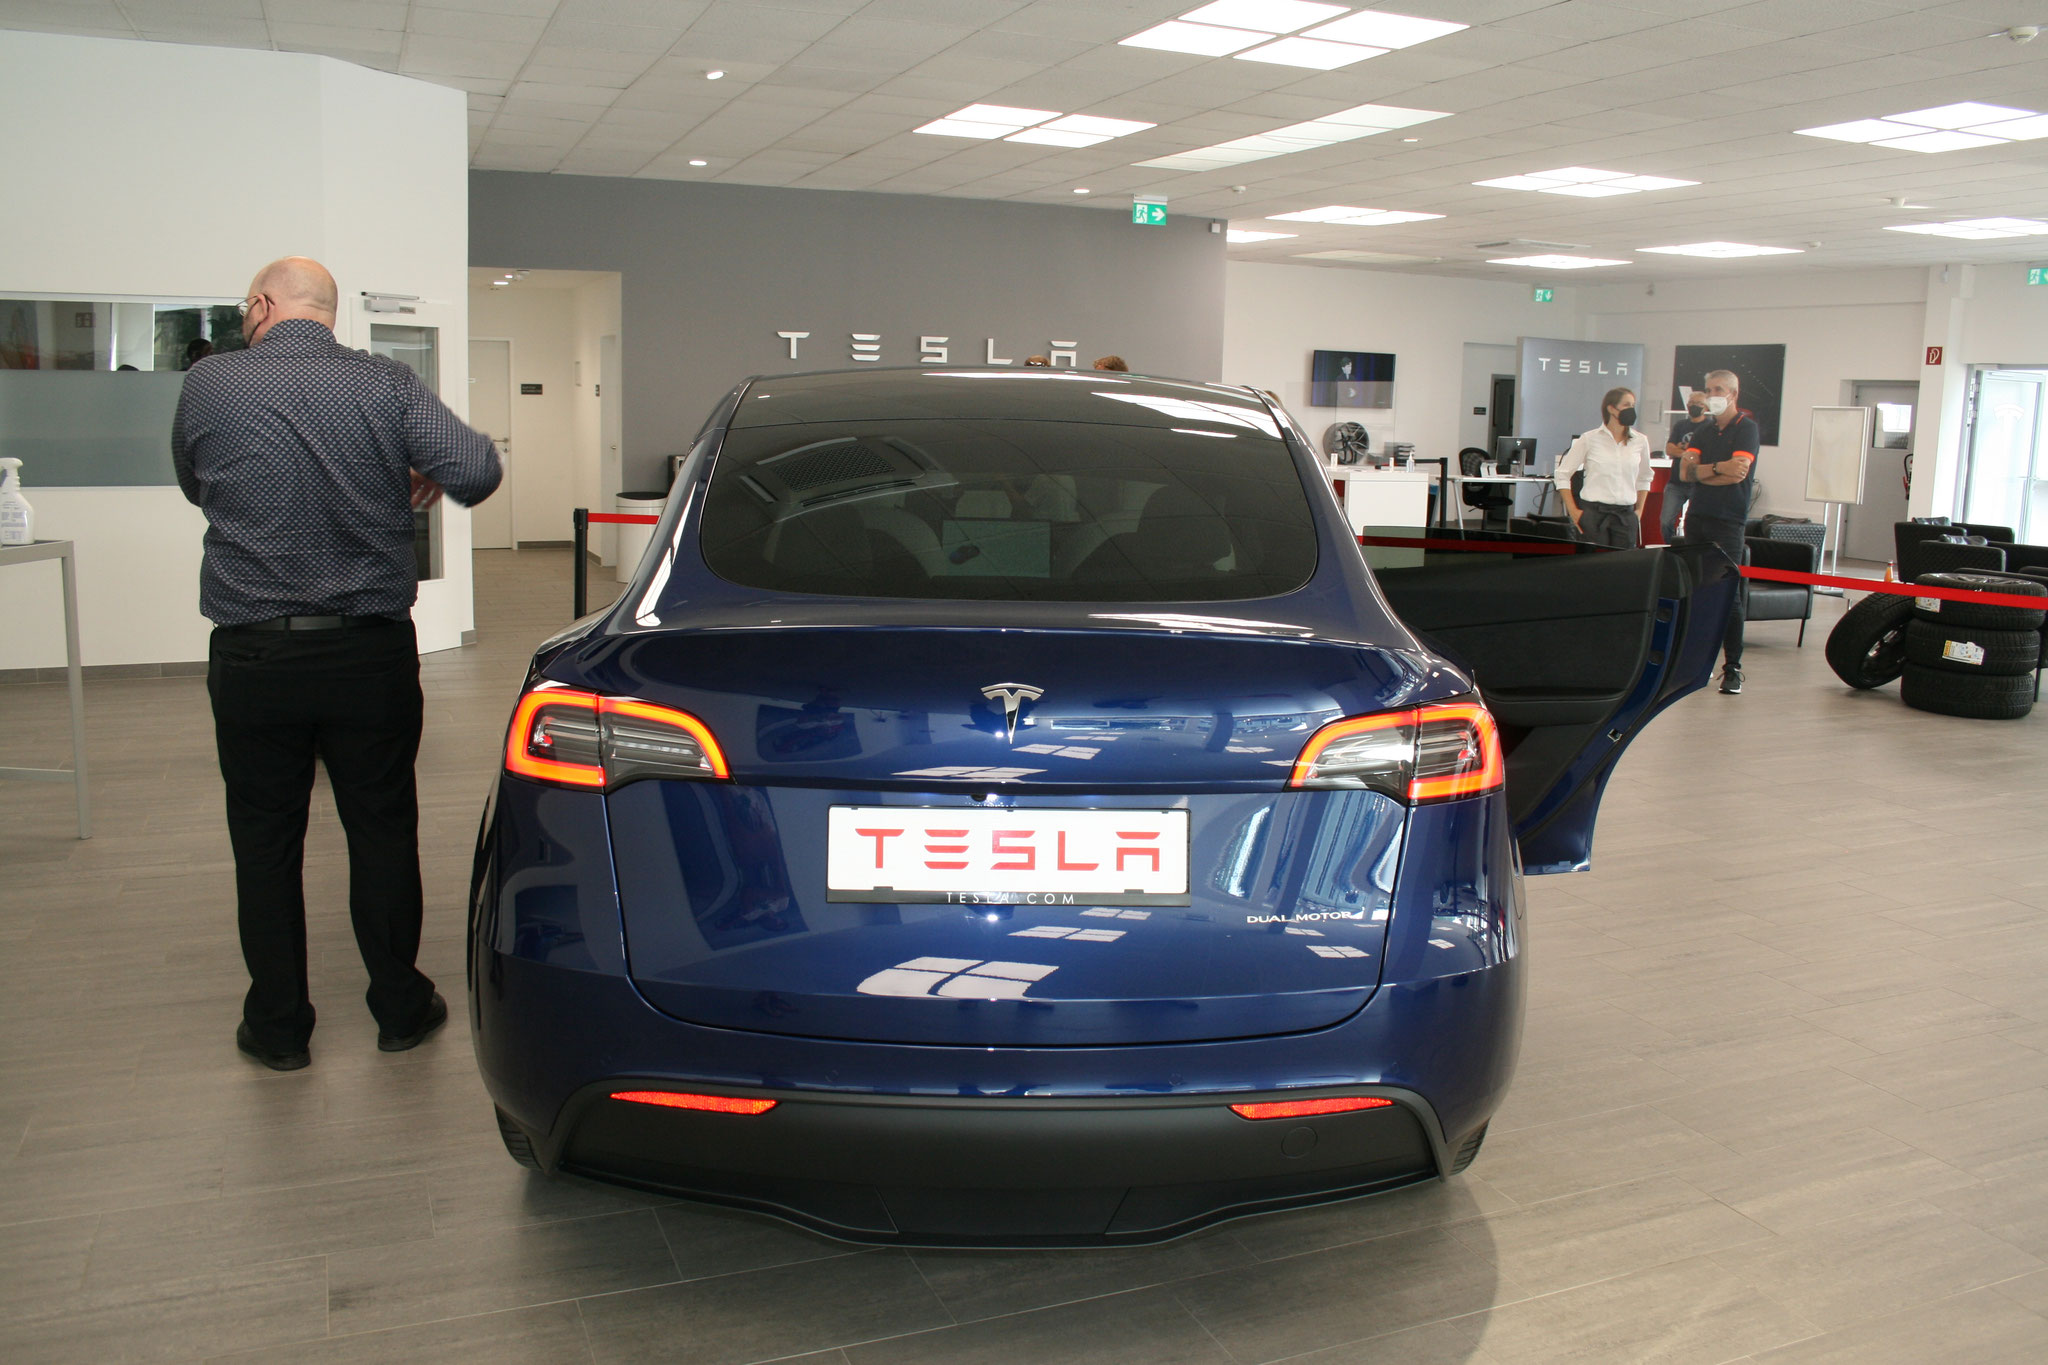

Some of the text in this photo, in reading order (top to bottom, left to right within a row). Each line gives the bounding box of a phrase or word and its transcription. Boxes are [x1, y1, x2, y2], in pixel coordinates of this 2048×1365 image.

[777, 331, 1078, 367] TESLA
[1538, 357, 1628, 376] TESLA
[855, 828, 1160, 872] TESLA
[946, 892, 1075, 905] TESLA.COM
[1246, 911, 1352, 924] DUAL MOTOR
